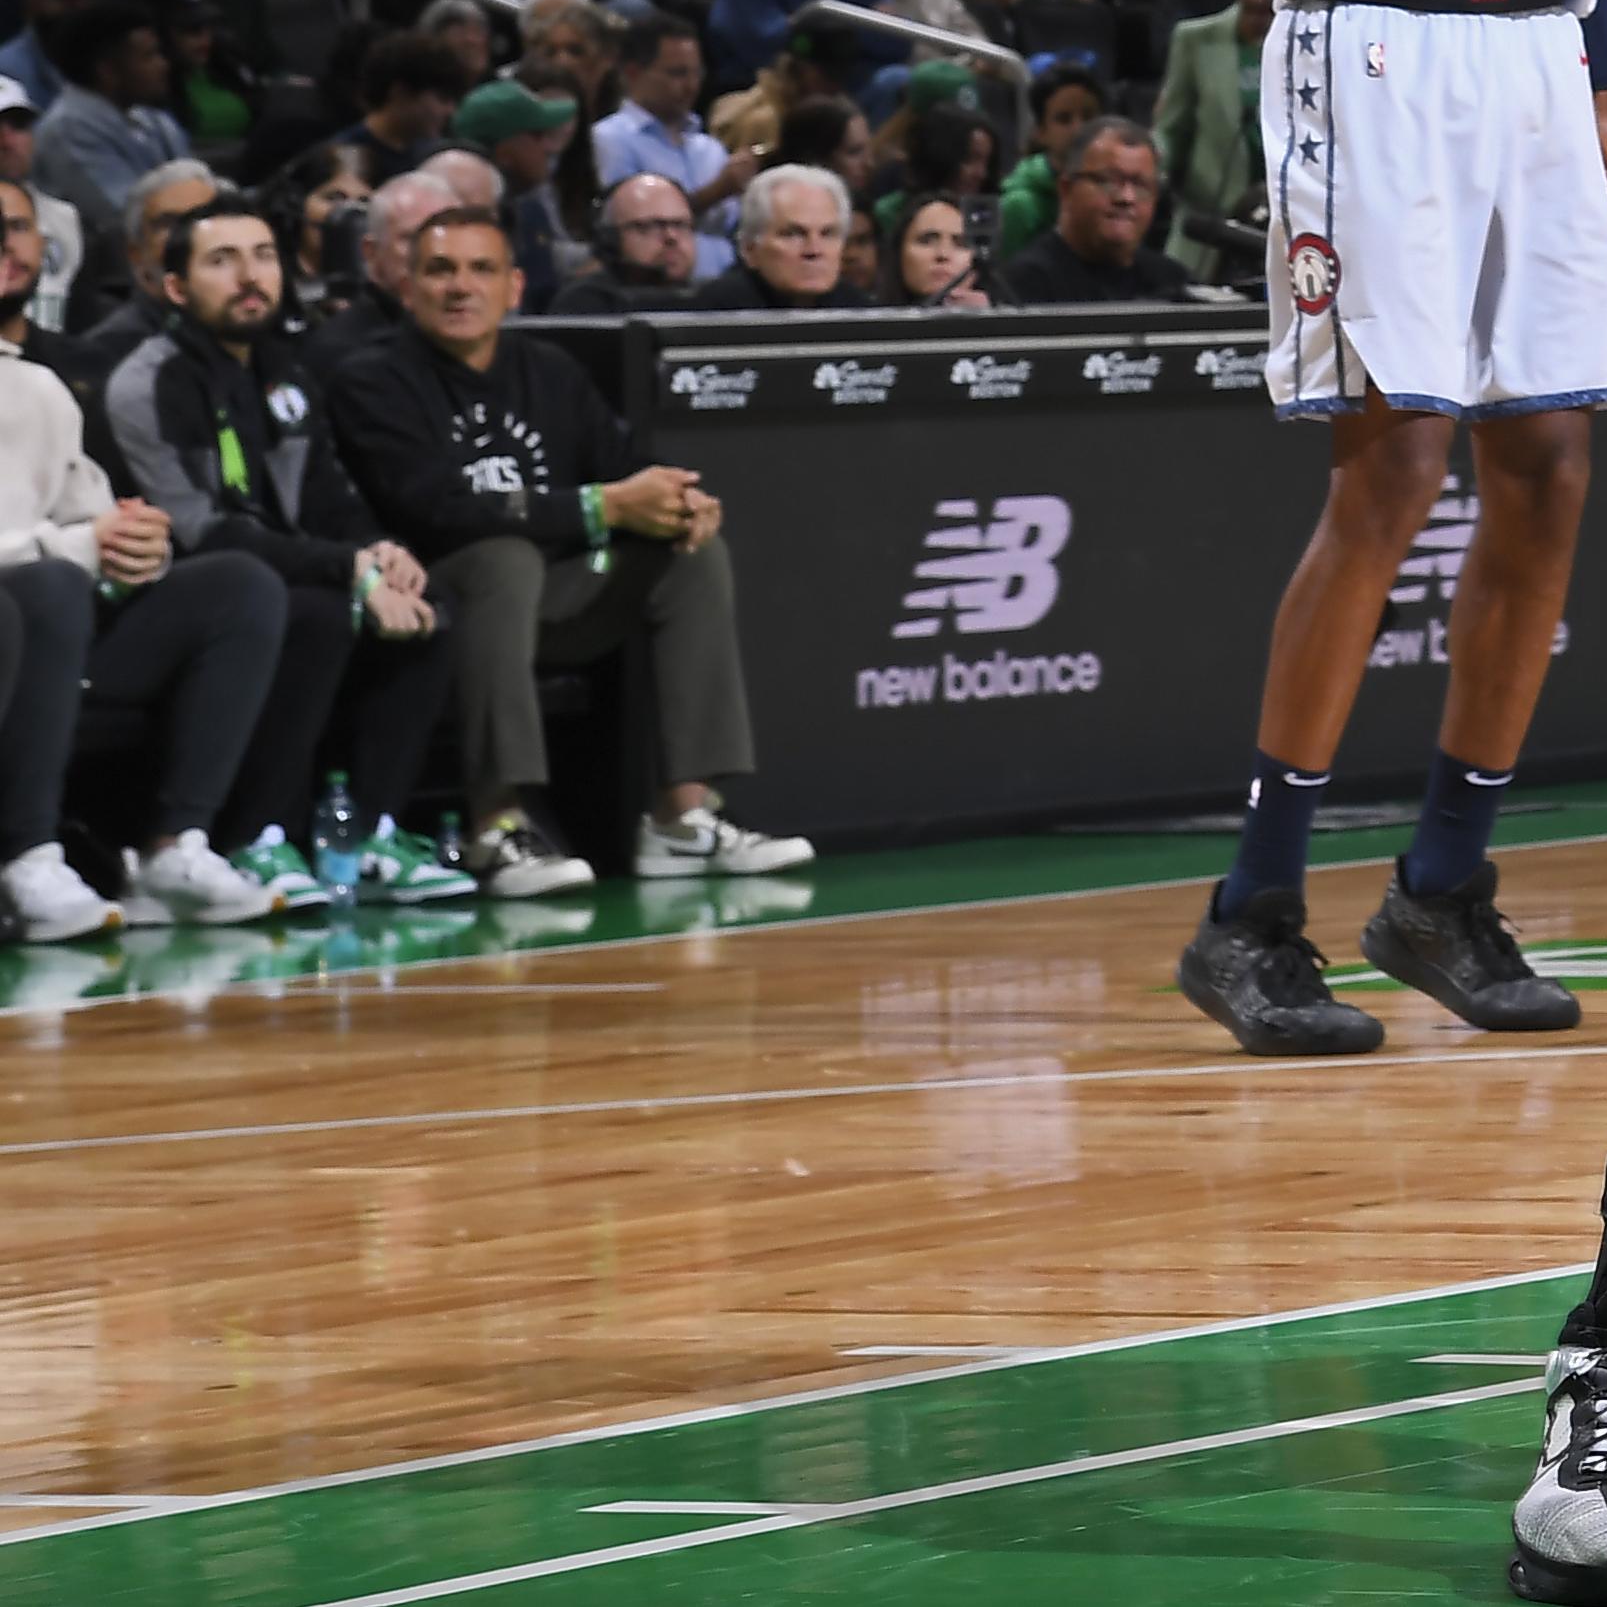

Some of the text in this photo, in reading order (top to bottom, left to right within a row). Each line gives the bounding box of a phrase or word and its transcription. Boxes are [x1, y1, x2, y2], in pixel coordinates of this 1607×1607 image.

[1366, 626, 1426, 668] ew
[856, 650, 1101, 709] new balance
